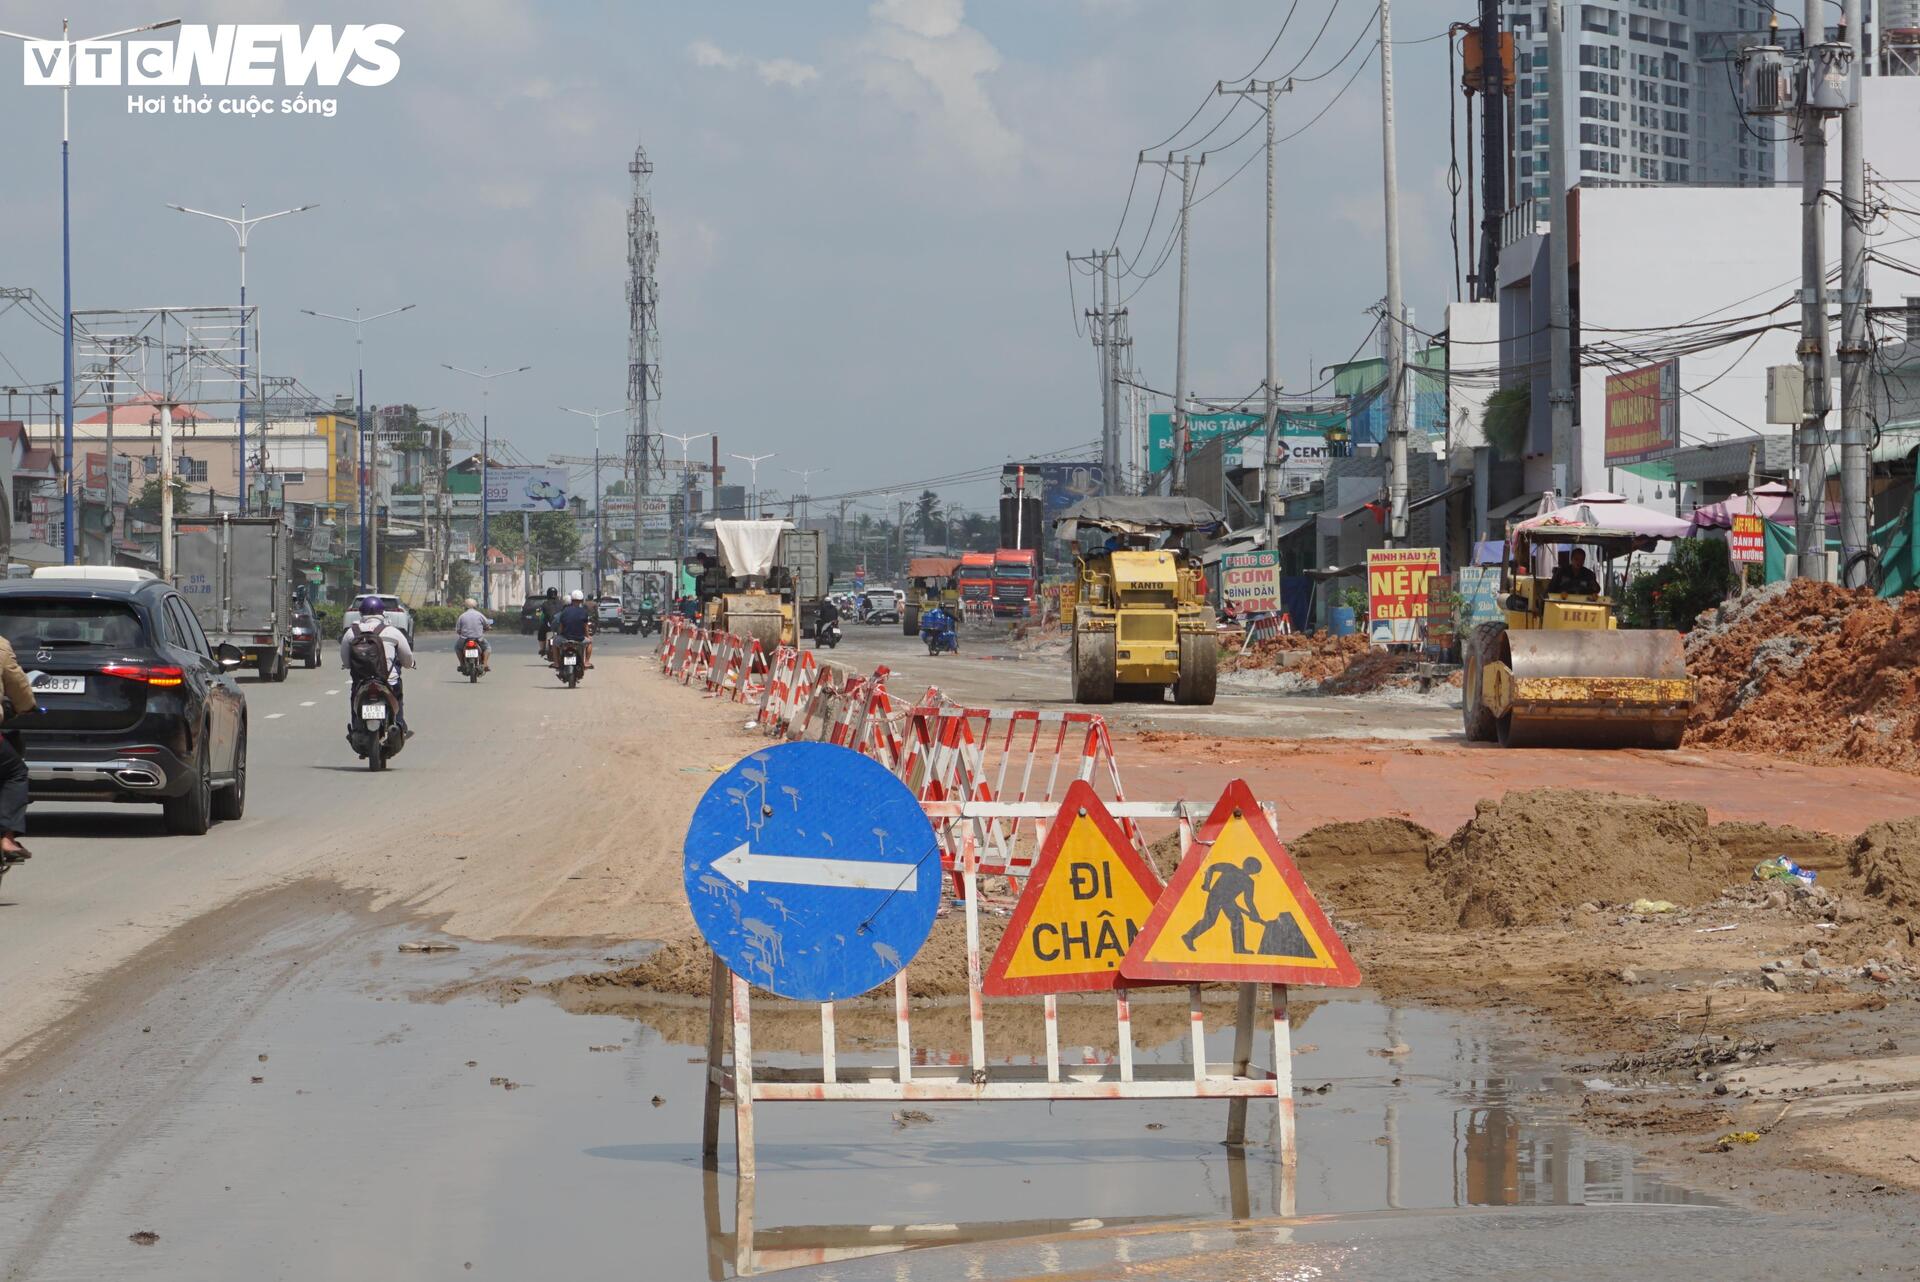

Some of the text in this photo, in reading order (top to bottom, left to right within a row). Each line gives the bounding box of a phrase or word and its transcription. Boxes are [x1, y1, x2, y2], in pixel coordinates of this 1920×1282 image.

[1292, 447, 1329, 458] CENT
[1371, 553, 1397, 561] MINH
[1228, 569, 1273, 584] CƠM
[1131, 582, 1164, 590] KANTO
[1229, 585, 1251, 598] BÌNH
[1069, 861, 1113, 900] ĐI
